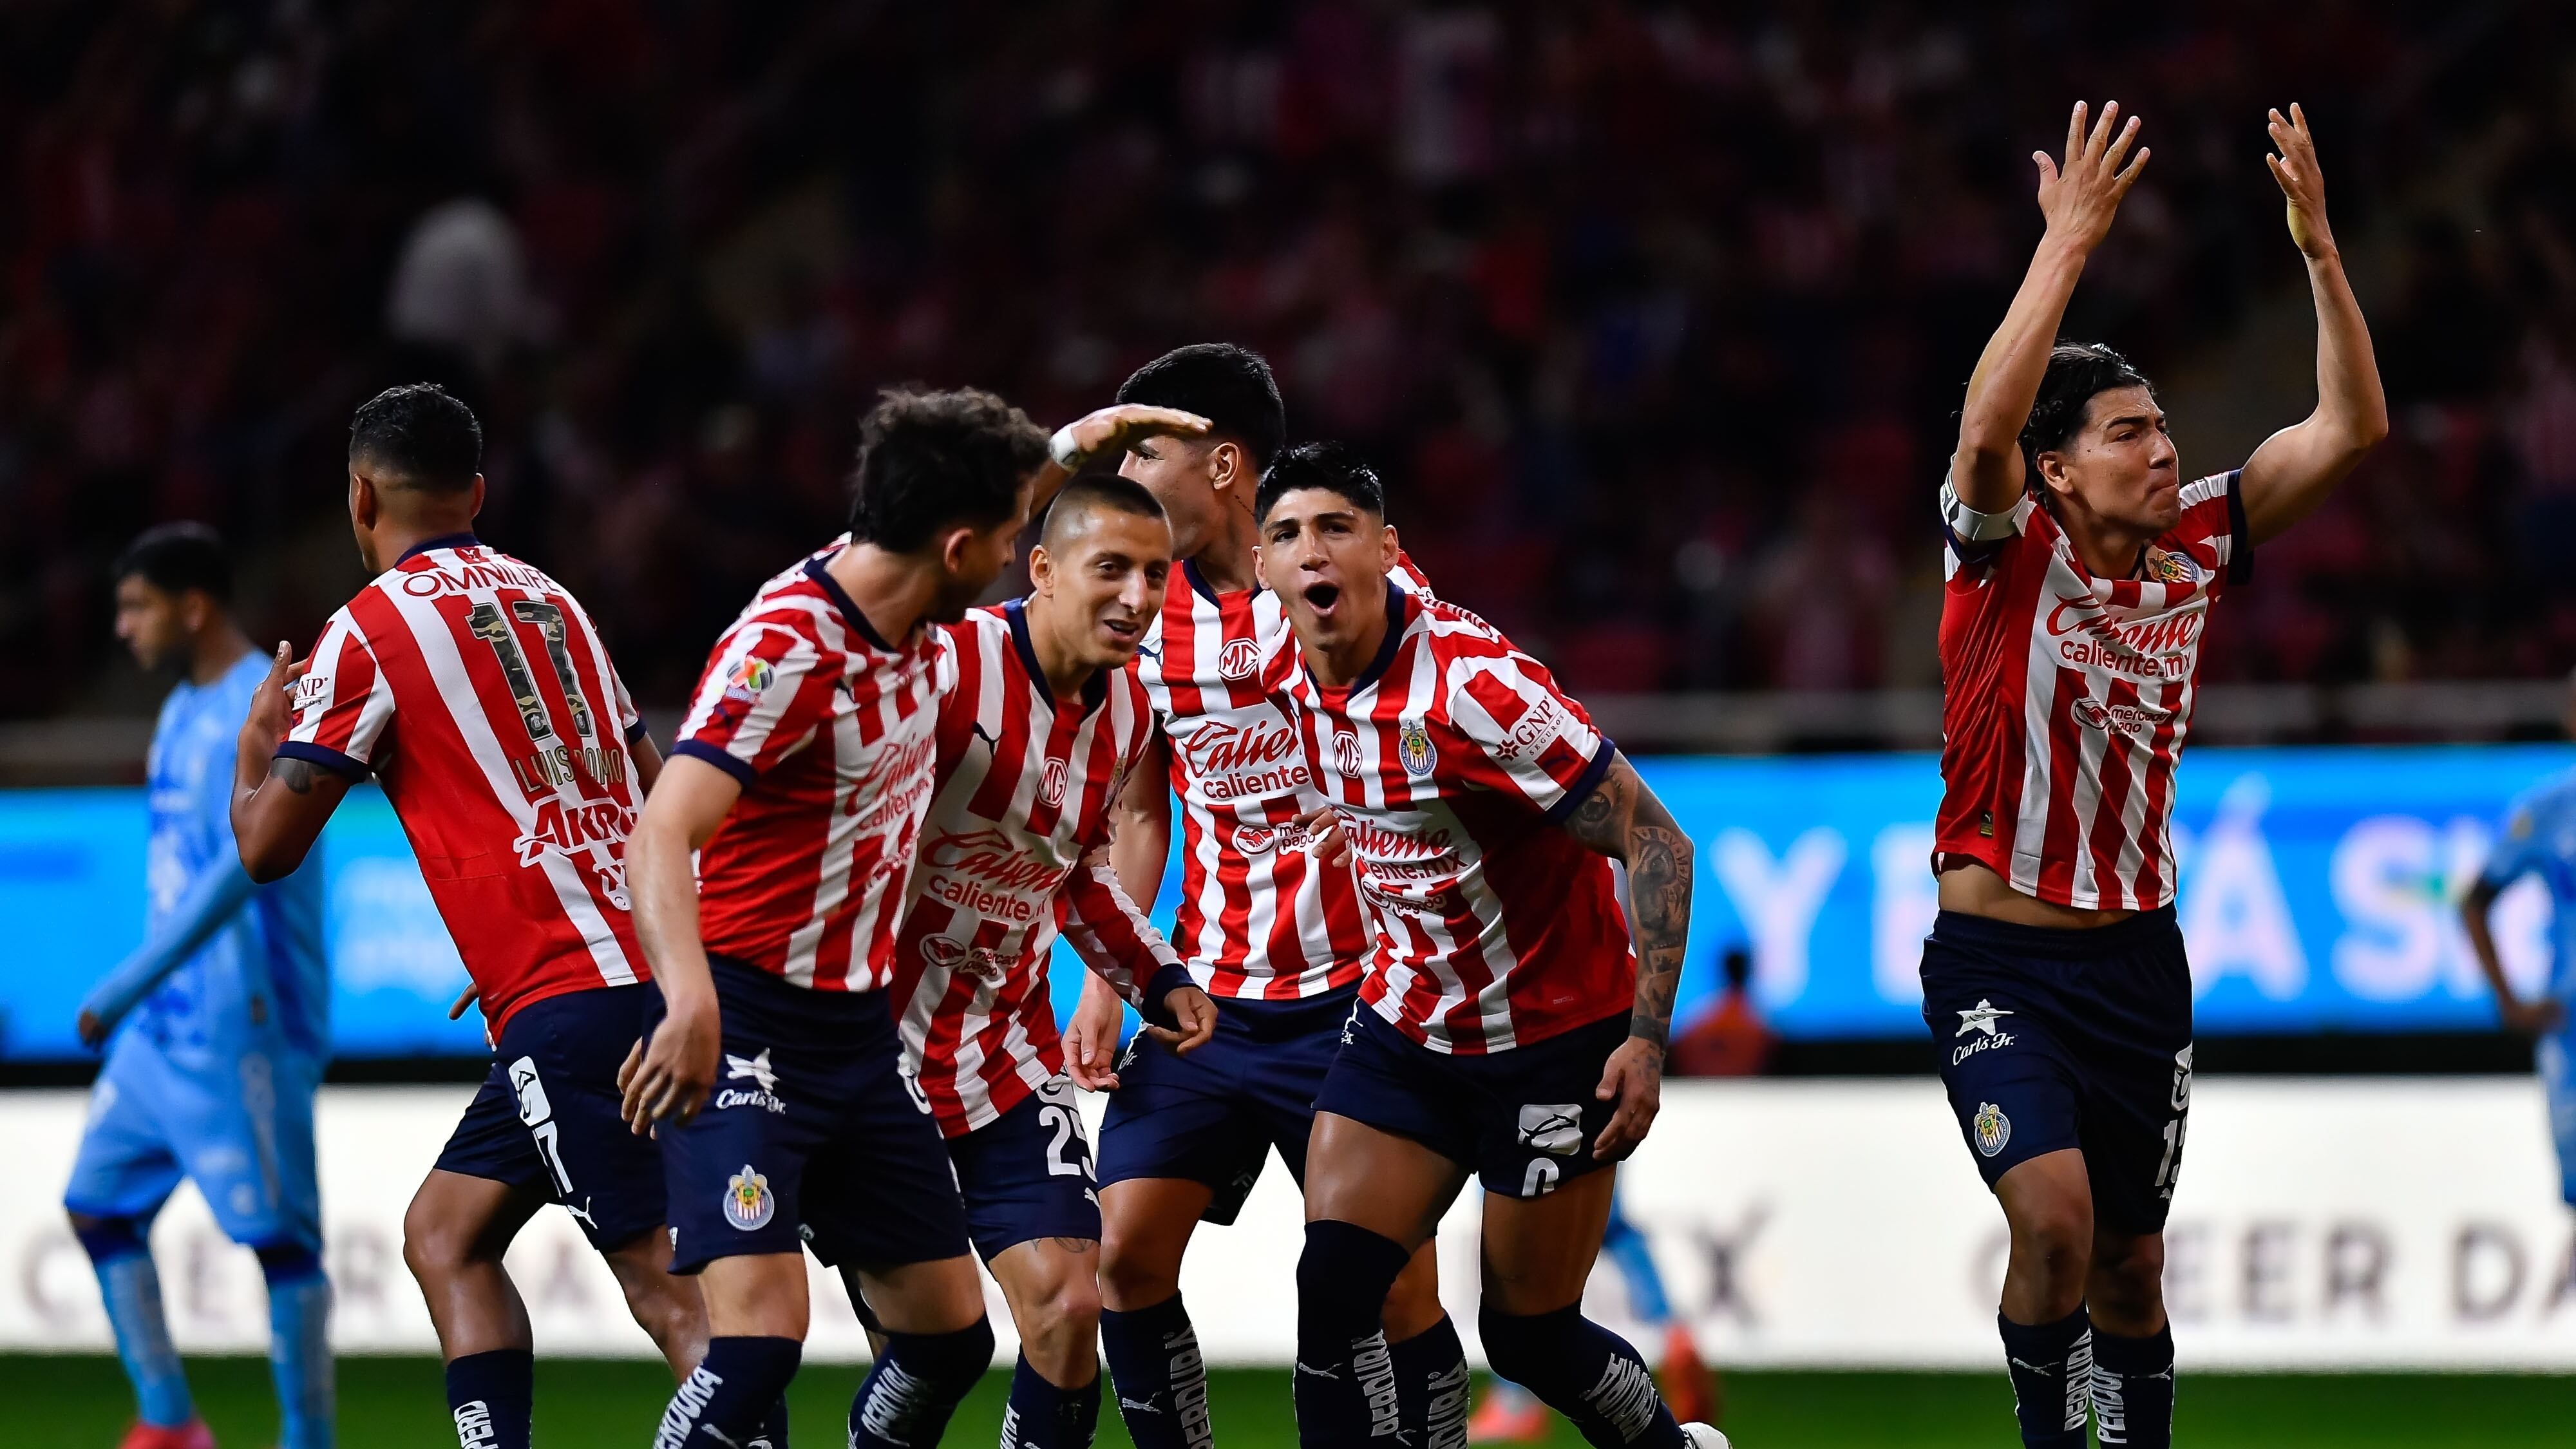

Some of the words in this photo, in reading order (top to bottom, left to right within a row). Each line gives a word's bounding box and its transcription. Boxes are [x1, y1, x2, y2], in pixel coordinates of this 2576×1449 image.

[403, 562, 562, 597] OMNILIFE
[465, 600, 592, 741] 17
[1222, 644, 1257, 675] MG
[2061, 639, 2191, 678] caliente.mx
[294, 677, 328, 699] NP
[1515, 696, 1554, 745] GNP
[1529, 714, 1564, 755] SEGUROS
[515, 746, 574, 793] LUIS
[1335, 737, 1360, 773] MG
[1203, 764, 1310, 799] caliente
[1870, 772, 2310, 1002] EÁ
[1953, 1036, 1990, 1066] Carl's
[1991, 1032, 2015, 1050] Jr.
[533, 1121, 573, 1198] 7
